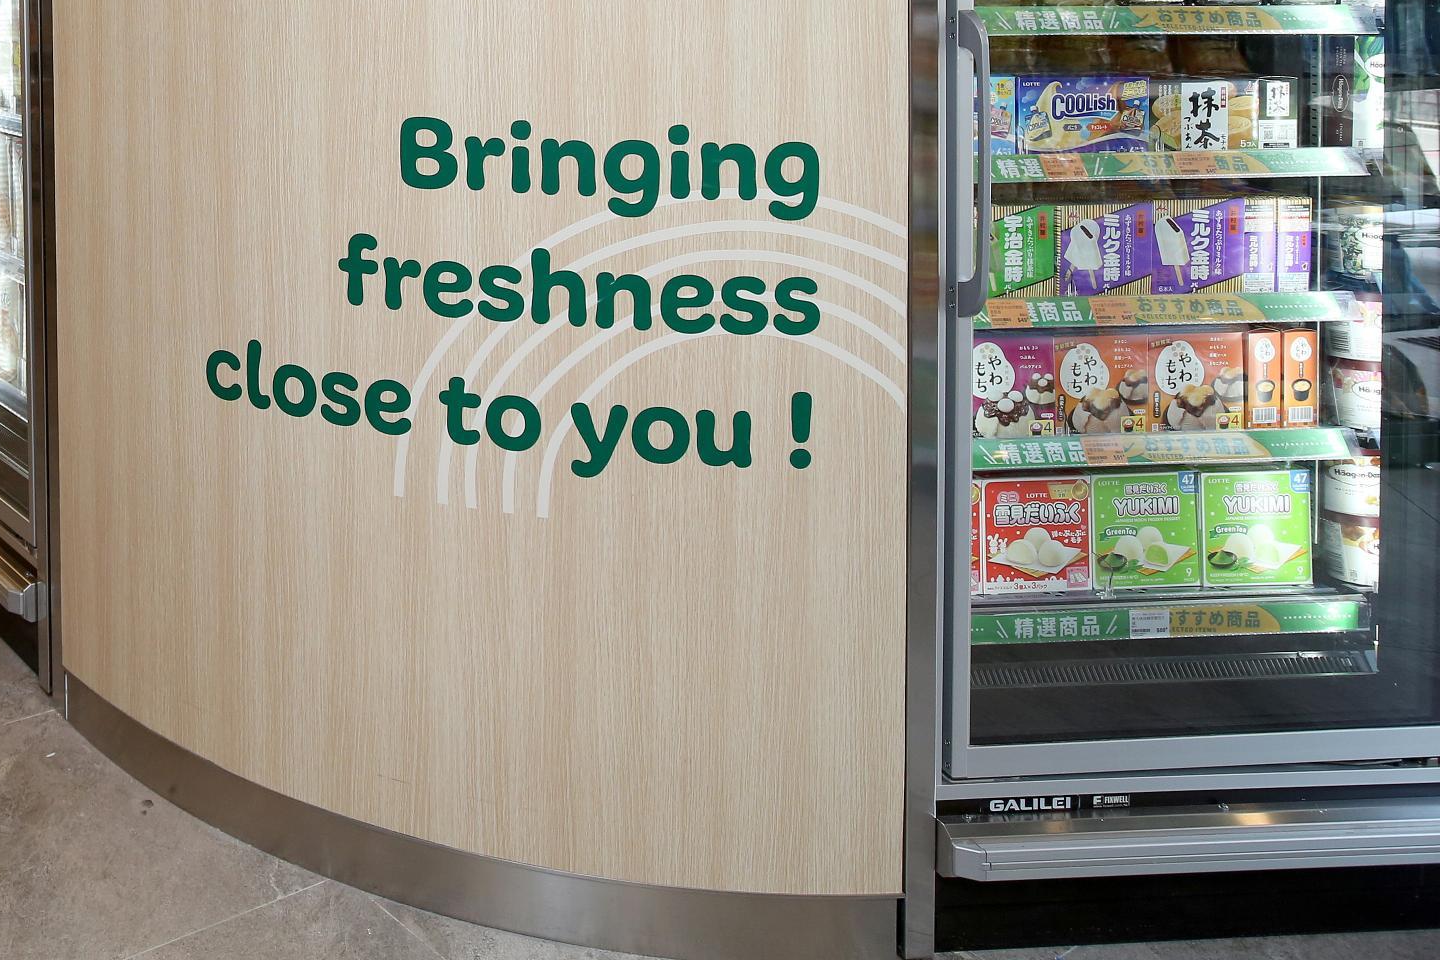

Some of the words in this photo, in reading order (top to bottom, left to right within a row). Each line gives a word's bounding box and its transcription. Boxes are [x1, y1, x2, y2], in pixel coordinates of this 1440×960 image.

[1014, 11, 1104, 31] 精選商品
[1159, 10, 1262, 29] おすすめ商品
[1050, 92, 1118, 121] COOLish
[1189, 86, 1220, 150] 抹茶
[1184, 116, 1194, 150] つぶあん
[400, 117, 820, 221] Bringing
[997, 158, 1044, 179] 精選
[339, 234, 821, 336] freshness
[1137, 297, 1244, 318] おすすめ商品
[206, 340, 412, 435] close
[439, 377, 542, 452] to
[571, 402, 752, 478] you
[790, 391, 813, 469] !
[1044, 421, 1053, 433] 4
[1135, 416, 1144, 429] 4
[1230, 416, 1239, 426] 4
[1181, 474, 1195, 485] 47
[1293, 472, 1308, 483] 47
[999, 493, 1018, 503] ミニ
[1112, 496, 1180, 517] YUKIMI
[1224, 494, 1291, 514] YUKIMI
[994, 502, 1081, 526] 雪見だいふく
[1186, 568, 1192, 577] 9
[1297, 566, 1303, 576] 9
[1014, 615, 1100, 639] 精選商品
[989, 796, 1071, 812] GALILEI
[1104, 795, 1129, 804] FIXWELL
